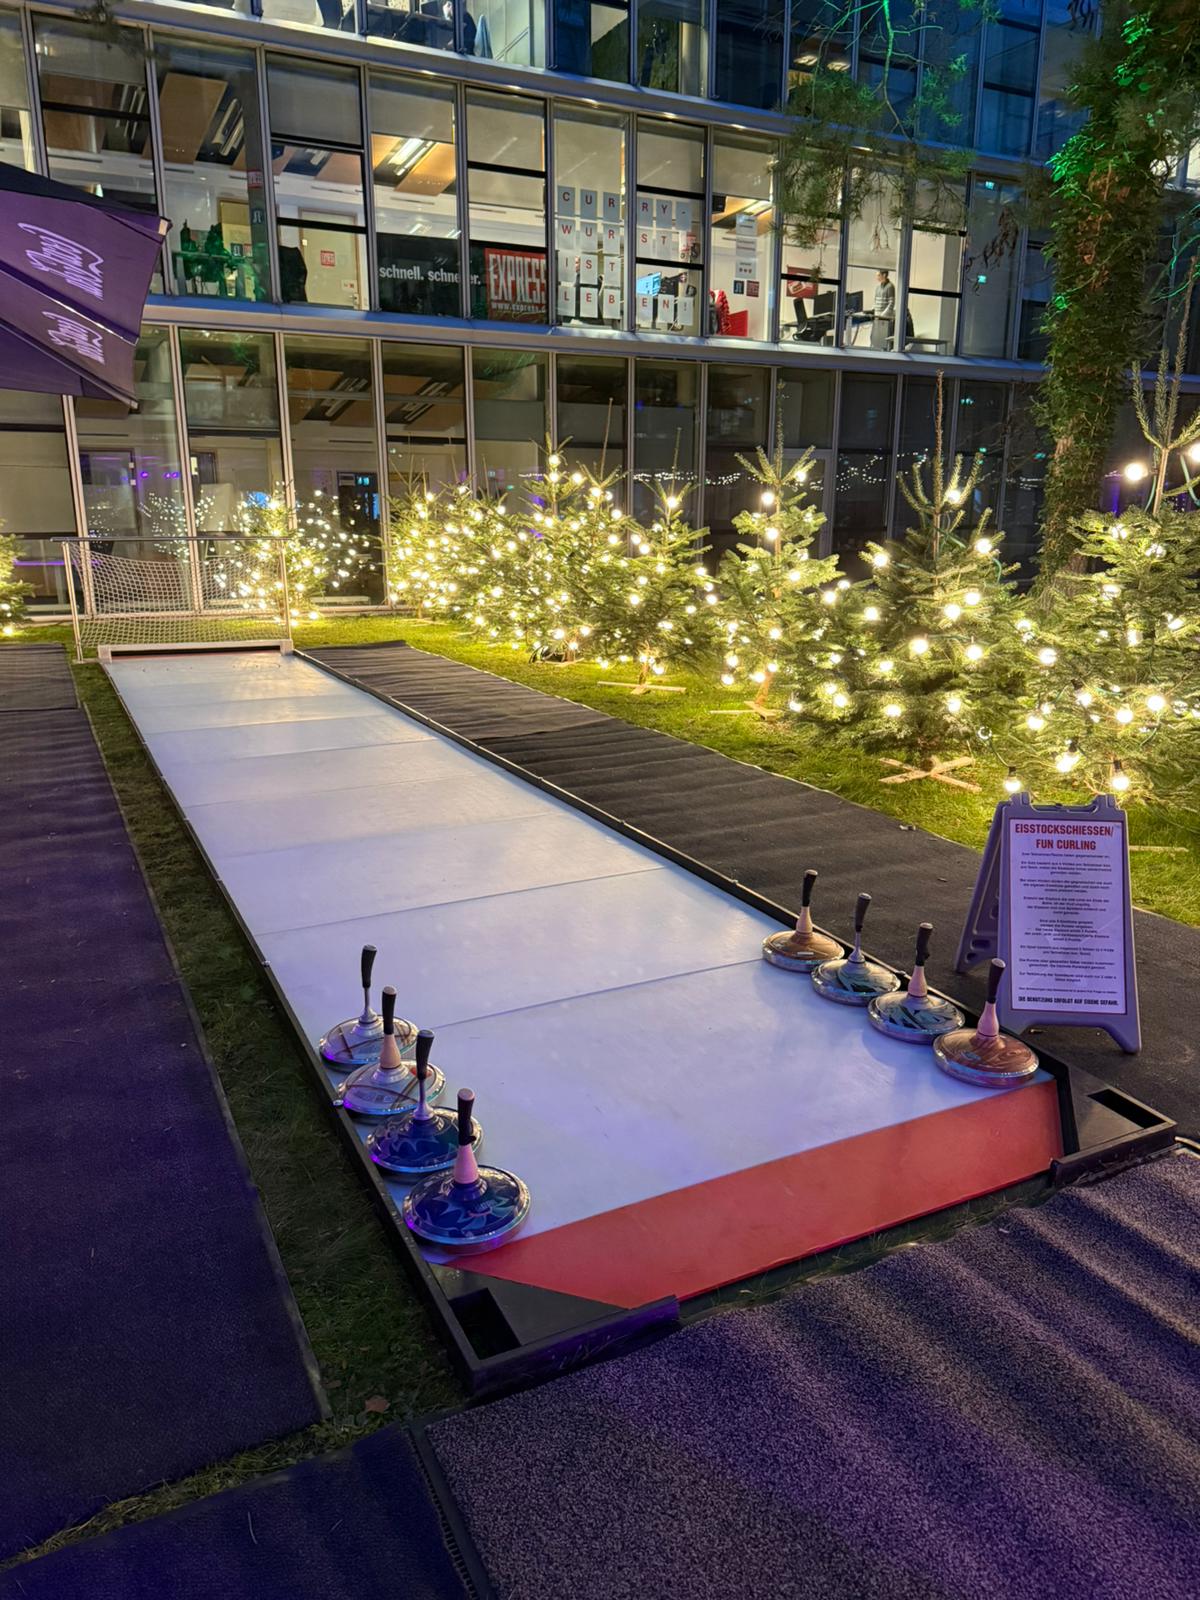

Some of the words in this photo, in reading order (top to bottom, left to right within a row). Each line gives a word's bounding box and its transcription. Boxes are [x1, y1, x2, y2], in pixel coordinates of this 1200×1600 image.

[561, 224, 667, 245] WURST
[565, 257, 616, 272] IST
[379, 264, 425, 281] schnell.
[427, 268, 481, 286] schneer.
[563, 290, 688, 312] LEBEN!
[1015, 823, 1114, 837] EISSTOCKSCHIESSEN/
[1036, 839, 1054, 849] FUN
[1056, 839, 1097, 851] CURLING
